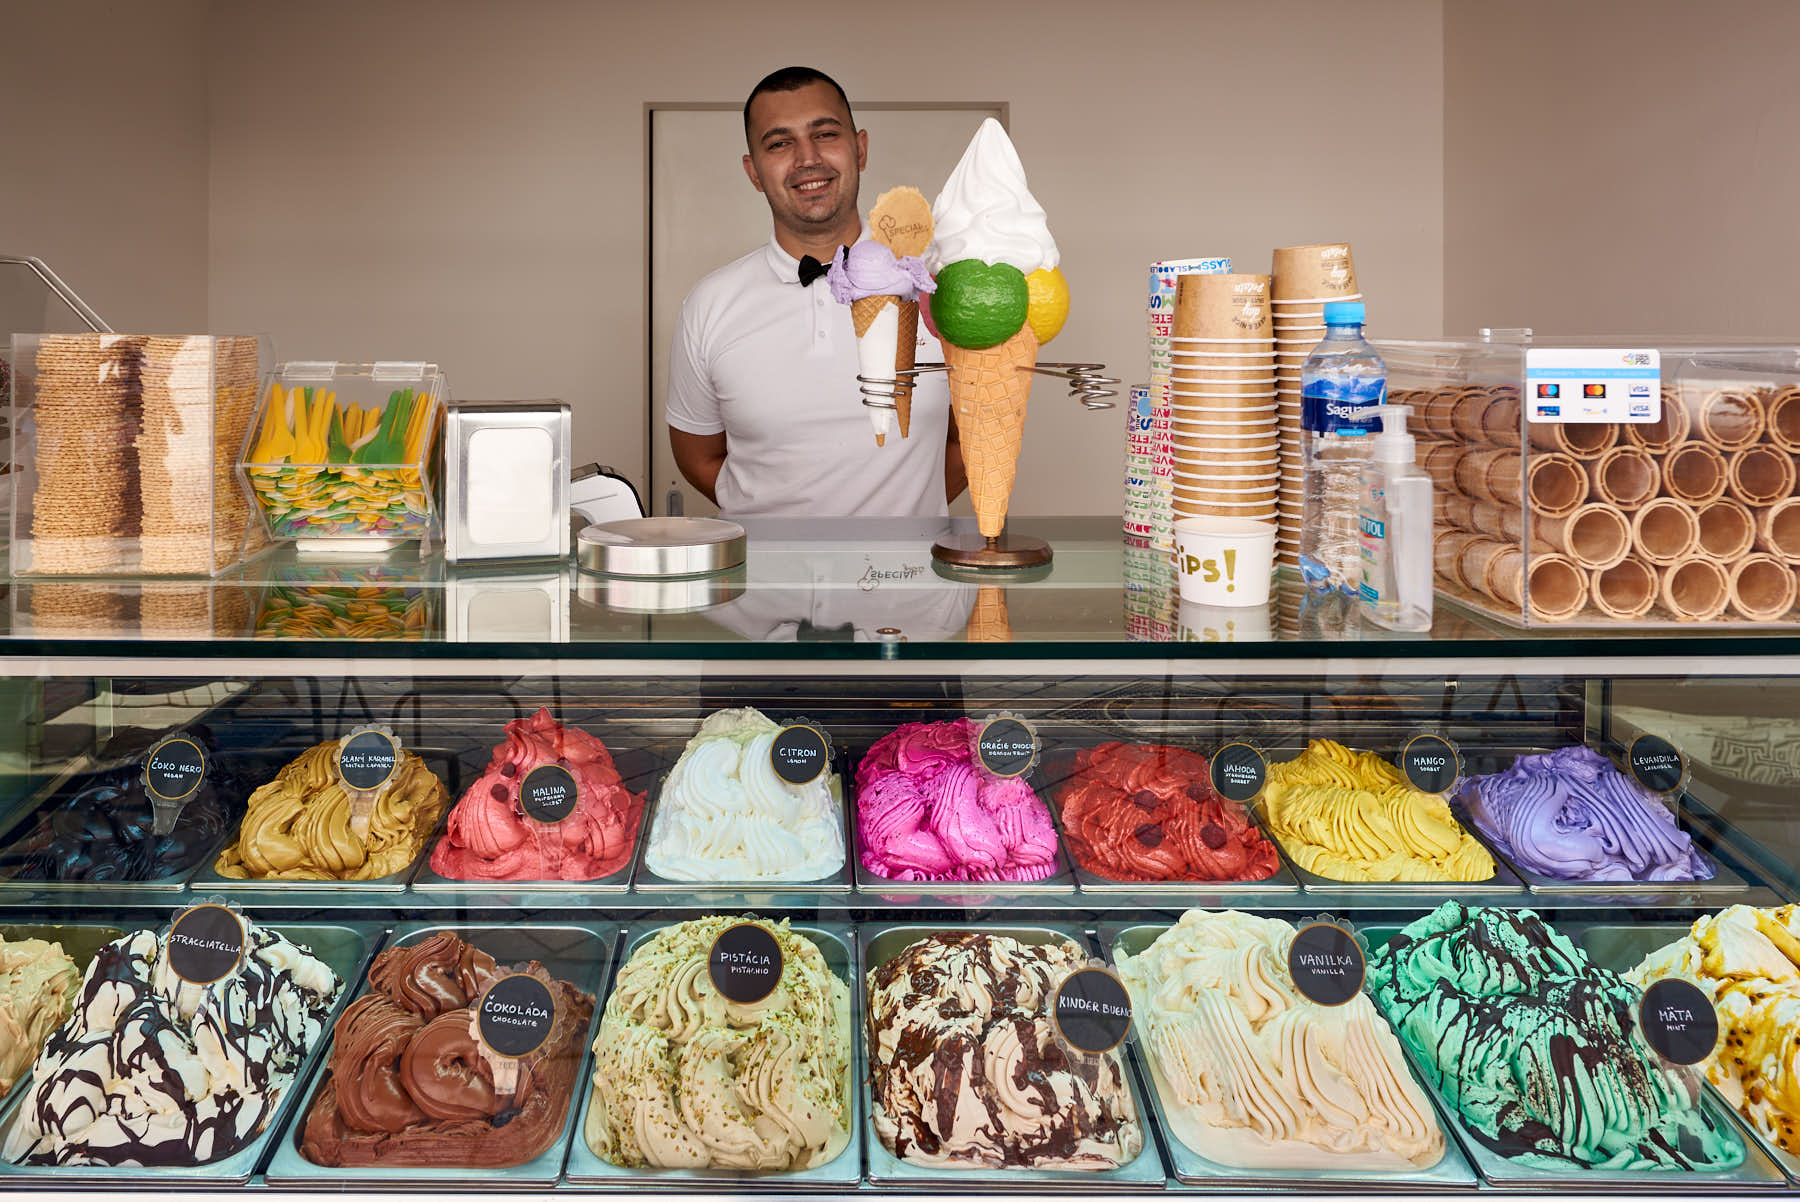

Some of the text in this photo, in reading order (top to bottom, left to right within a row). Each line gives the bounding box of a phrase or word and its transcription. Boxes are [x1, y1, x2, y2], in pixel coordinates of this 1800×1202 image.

[779, 747, 817, 757] CITRON
[151, 757, 202, 773] ČOKO NERO
[368, 755, 397, 763] KARAMEL
[1413, 757, 1446, 766] MANGO
[1223, 764, 1256, 775] JAHODA
[532, 786, 566, 797] MALINA
[170, 934, 242, 954] STRACCIATELLA
[720, 950, 771, 965] PISTÁCIA
[1299, 954, 1353, 966] VANILKA
[731, 966, 769, 975] PISTACHIO
[1311, 968, 1345, 976] VANILLA
[484, 994, 548, 1019] ČOKOLÁDA
[1059, 995, 1099, 1013] KINDER
[1658, 1006, 1694, 1022] MÄTA
[492, 1015, 538, 1027] CHOCOLATE
